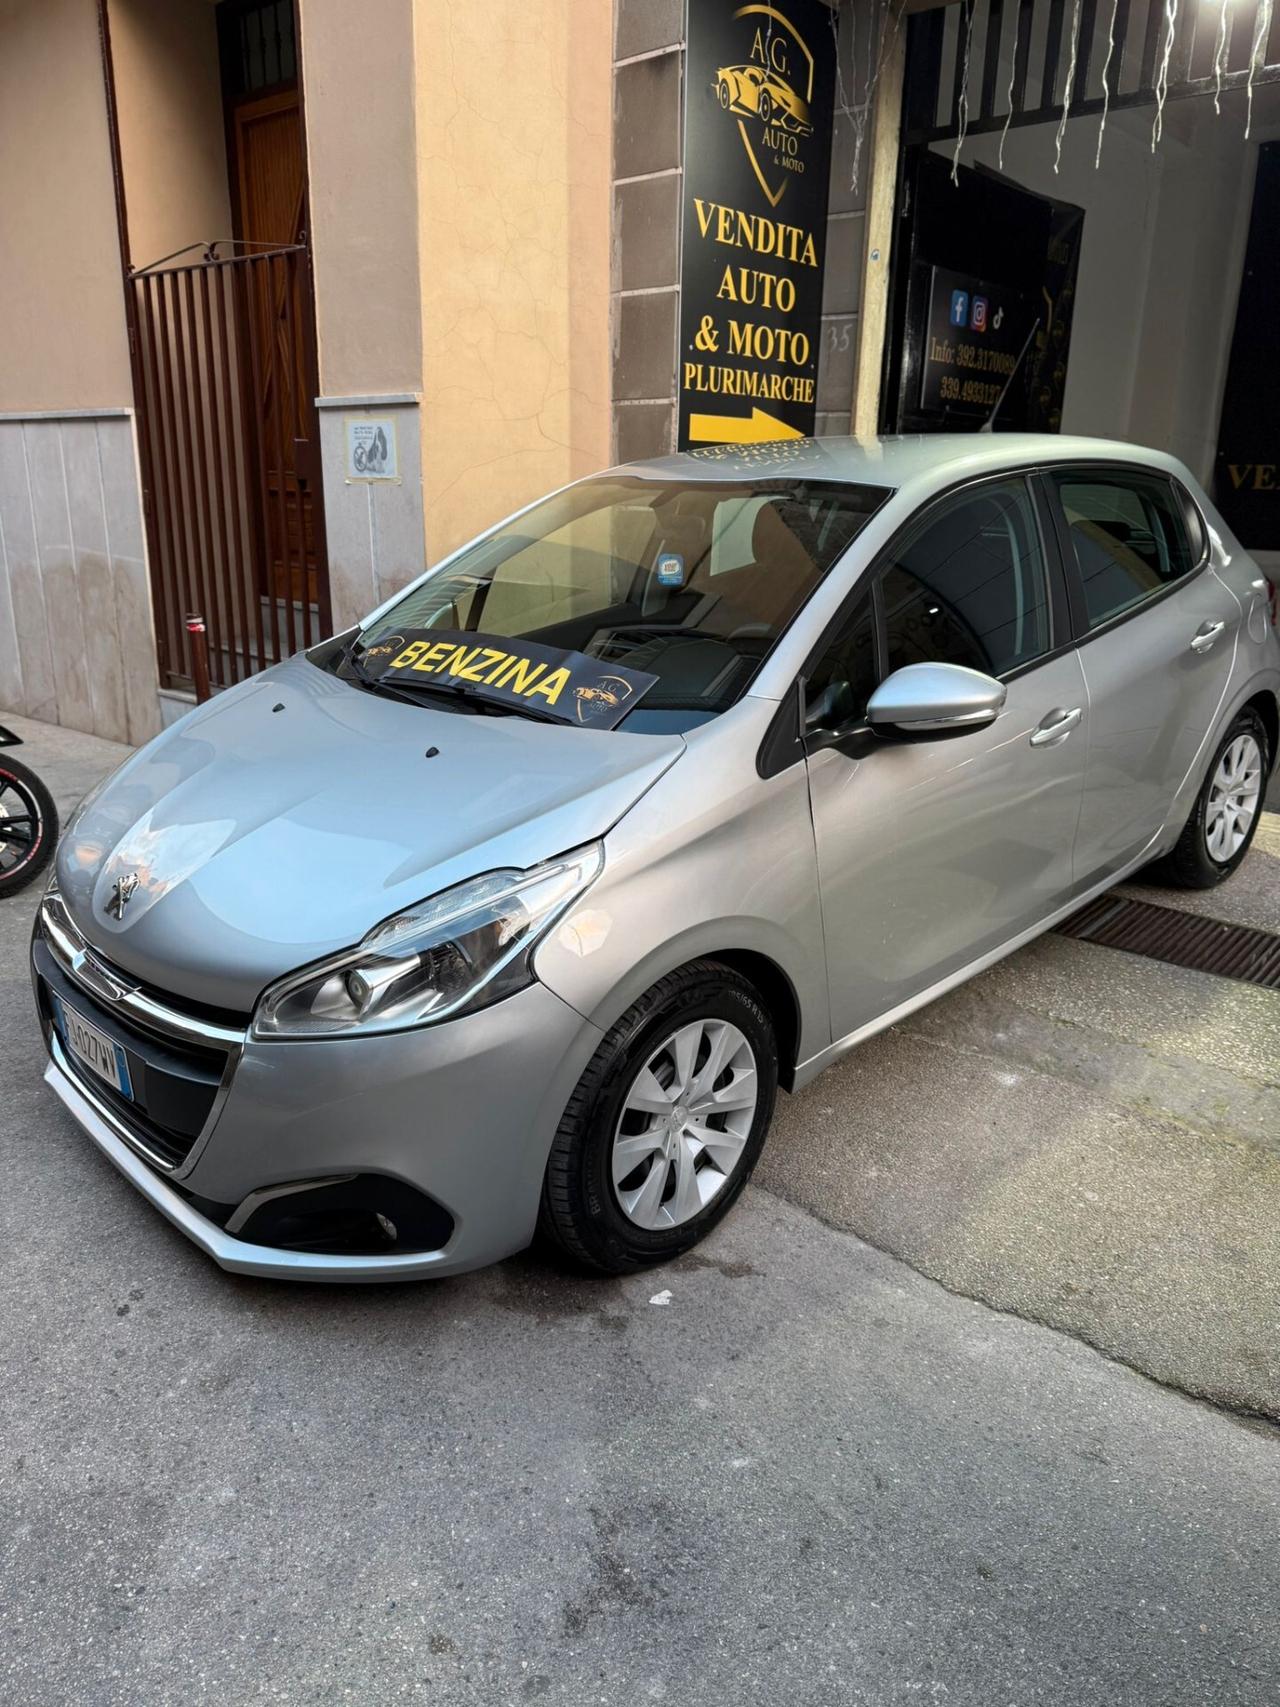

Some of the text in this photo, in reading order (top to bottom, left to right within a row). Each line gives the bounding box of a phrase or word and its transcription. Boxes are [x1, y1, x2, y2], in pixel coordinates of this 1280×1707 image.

[762, 127, 798, 156] AUTO
[782, 156, 805, 173] MOTO
[693, 198, 818, 267] VENDITA
[716, 264, 796, 313] AUTO
[695, 315, 809, 366] & MOTO
[929, 337, 955, 363] Info:
[683, 362, 814, 403] PLURIMARCHE
[1228, 464, 1280, 490] VE
[389, 640, 572, 705] BENZINA
